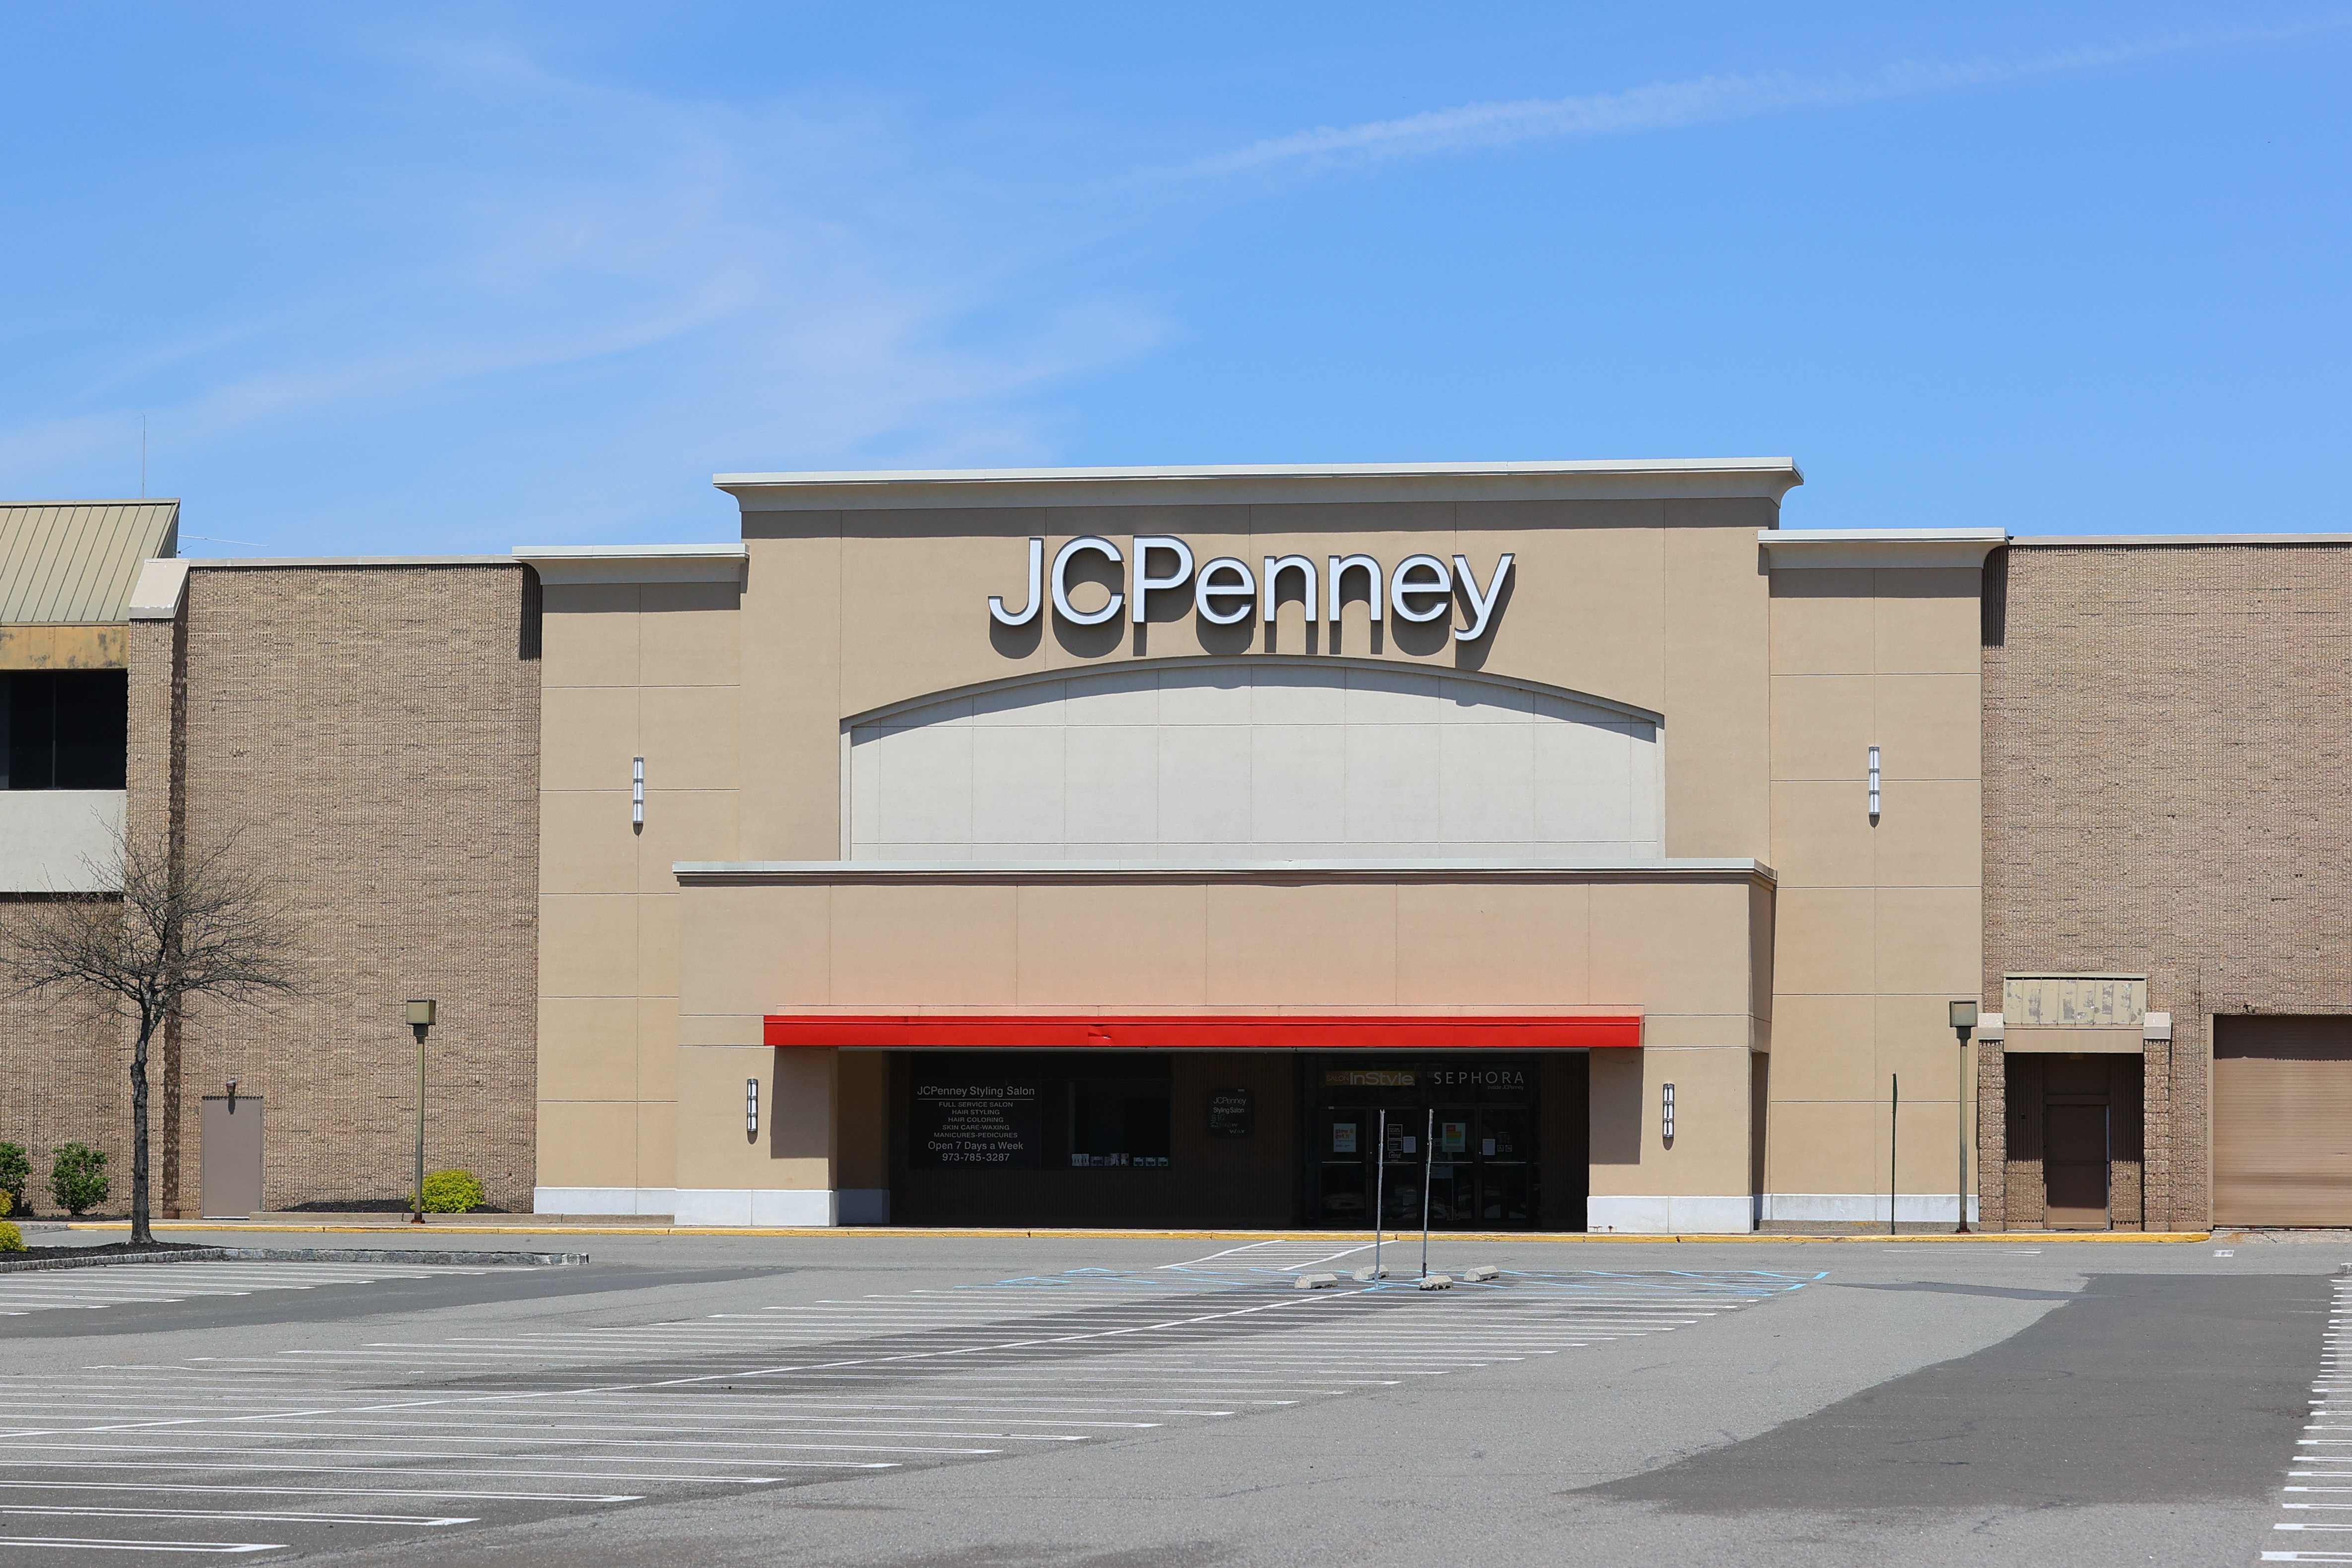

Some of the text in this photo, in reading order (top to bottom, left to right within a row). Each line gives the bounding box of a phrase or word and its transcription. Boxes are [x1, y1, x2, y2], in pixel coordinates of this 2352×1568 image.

[988, 536, 1516, 641] JCPenney
[1350, 1072, 1414, 1086] InStyle
[1434, 1072, 1523, 1084] SEPHORA
[917, 1086, 1035, 1097] JCPenney Styling Salon
[1213, 1096, 1246, 1105] JCPenney
[928, 1141, 953, 1151] Open
[965, 1142, 987, 1152] Days
[942, 1153, 1010, 1161] 973-785-3287
